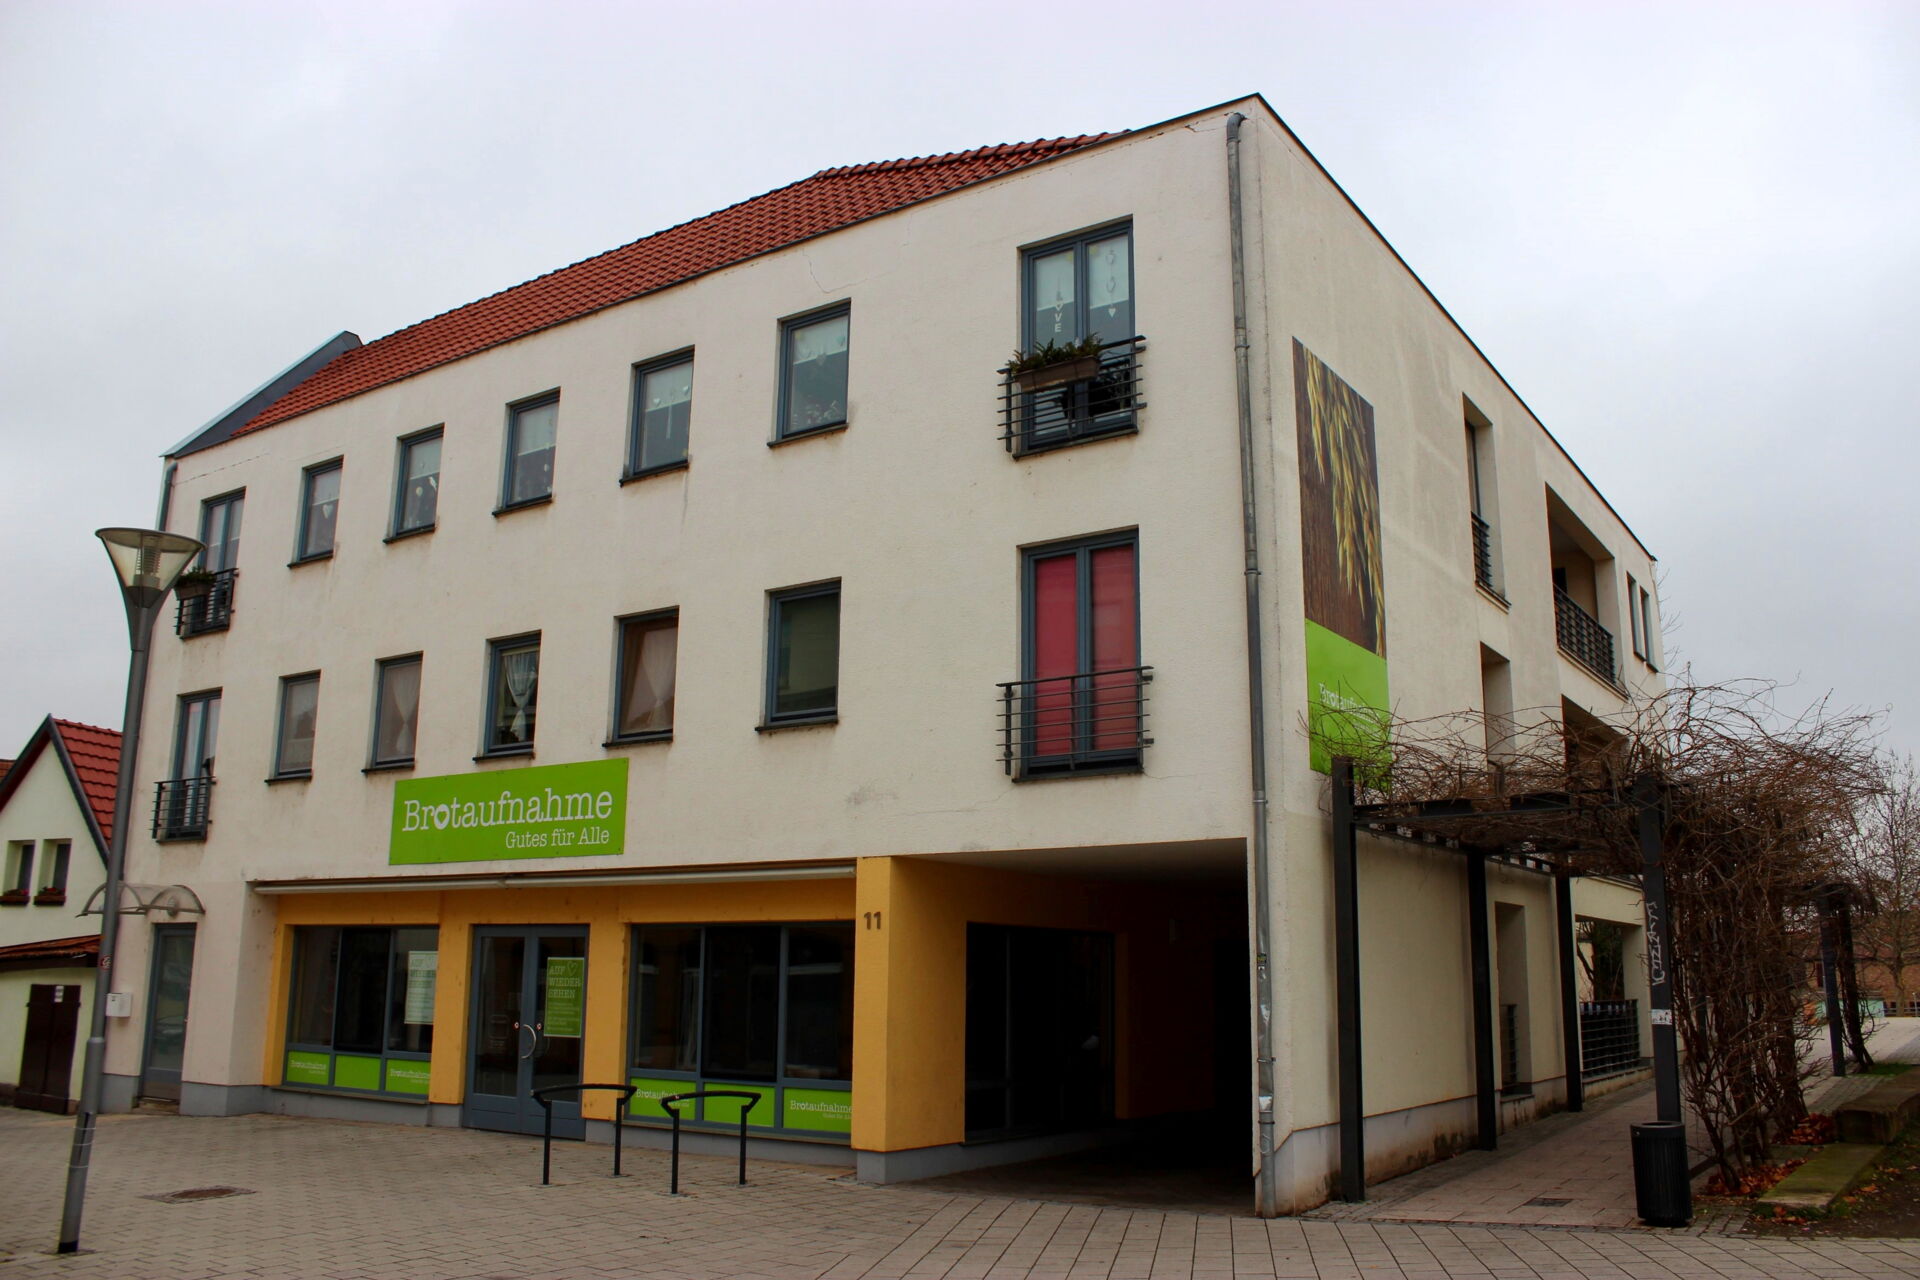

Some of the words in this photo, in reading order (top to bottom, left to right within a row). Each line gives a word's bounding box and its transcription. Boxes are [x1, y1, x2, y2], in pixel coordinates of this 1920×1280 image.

[402, 787, 613, 832] Brotaufnahme
[505, 831, 548, 848] Gutes
[551, 828, 575, 847] für
[578, 827, 610, 845] Alle
[864, 911, 881, 930] 11
